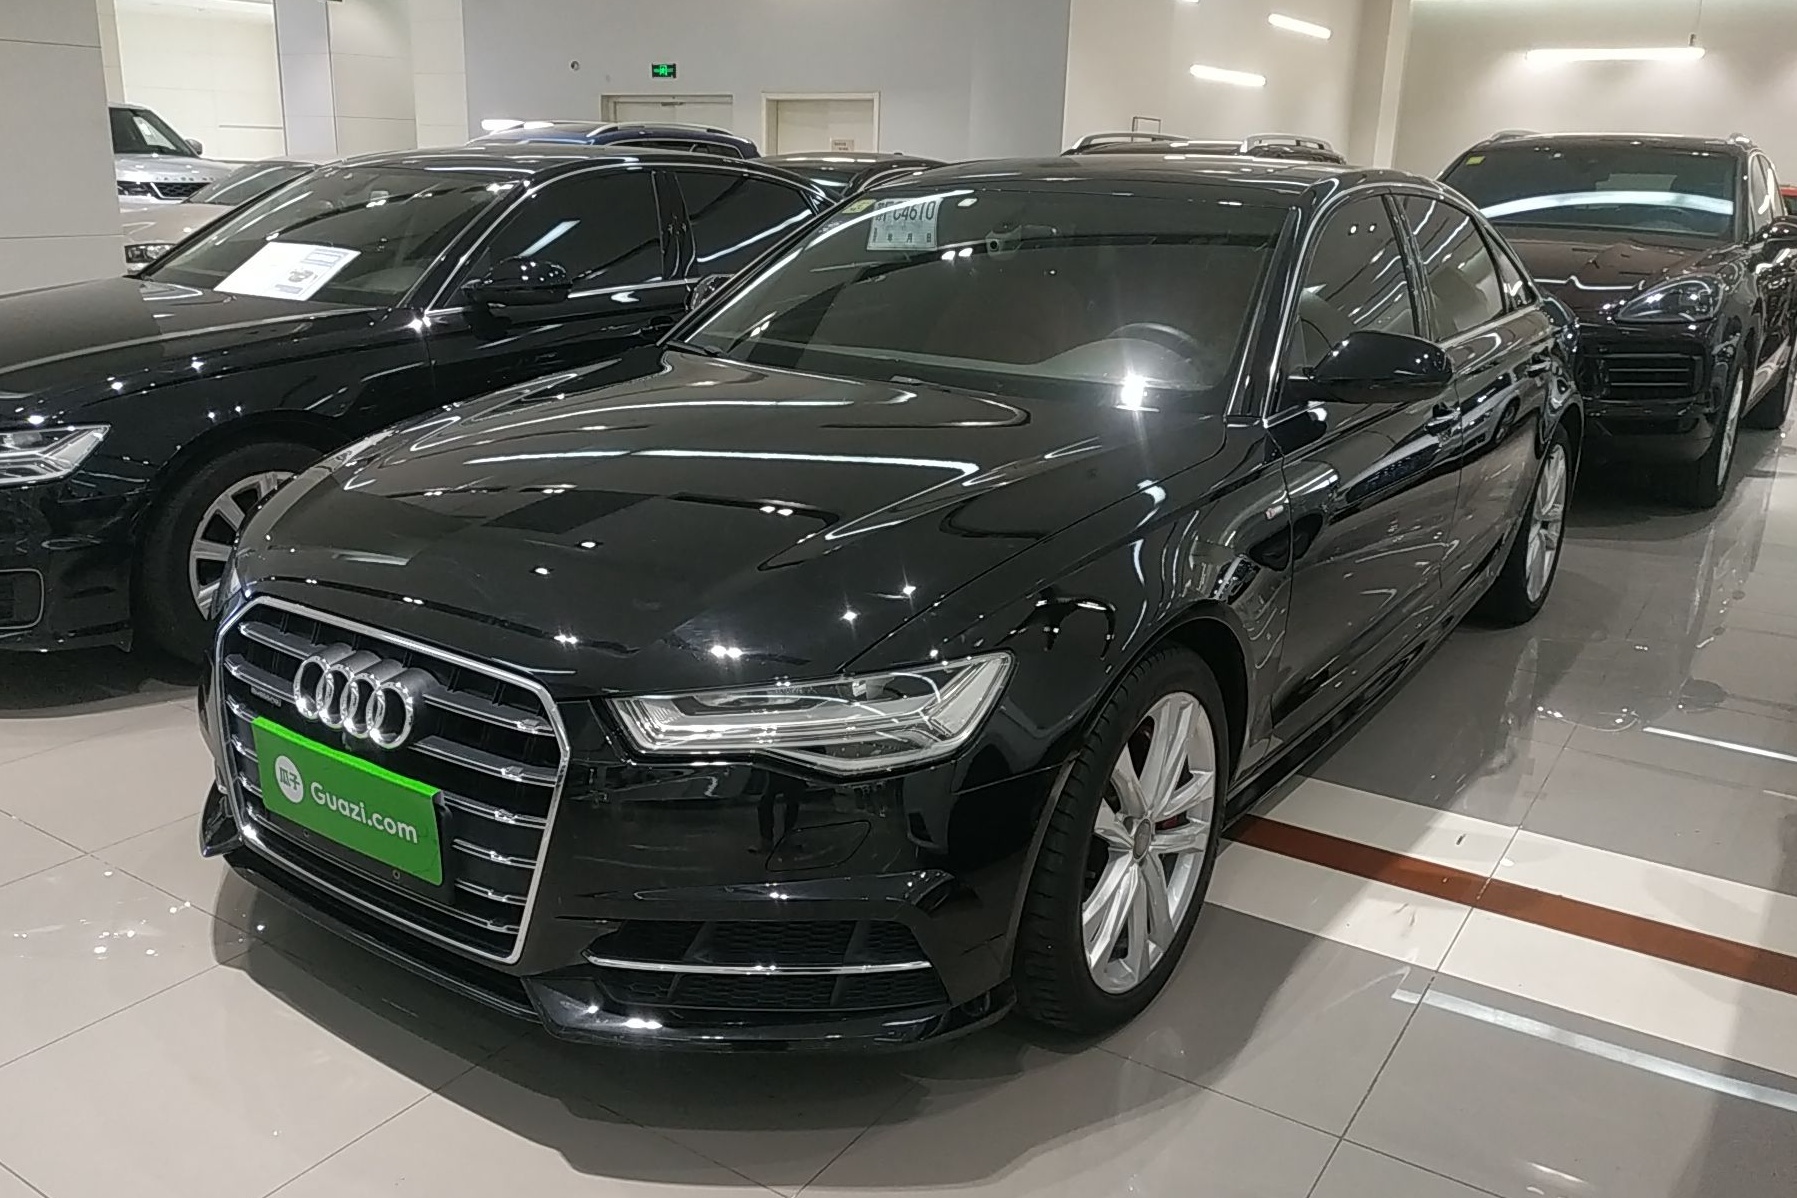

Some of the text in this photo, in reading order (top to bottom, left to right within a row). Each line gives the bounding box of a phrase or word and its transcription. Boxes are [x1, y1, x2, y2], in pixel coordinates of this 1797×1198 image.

[926, 233, 932, 243] 日
[278, 766, 301, 791] 瓜子
[310, 781, 418, 844] Guazi.com
